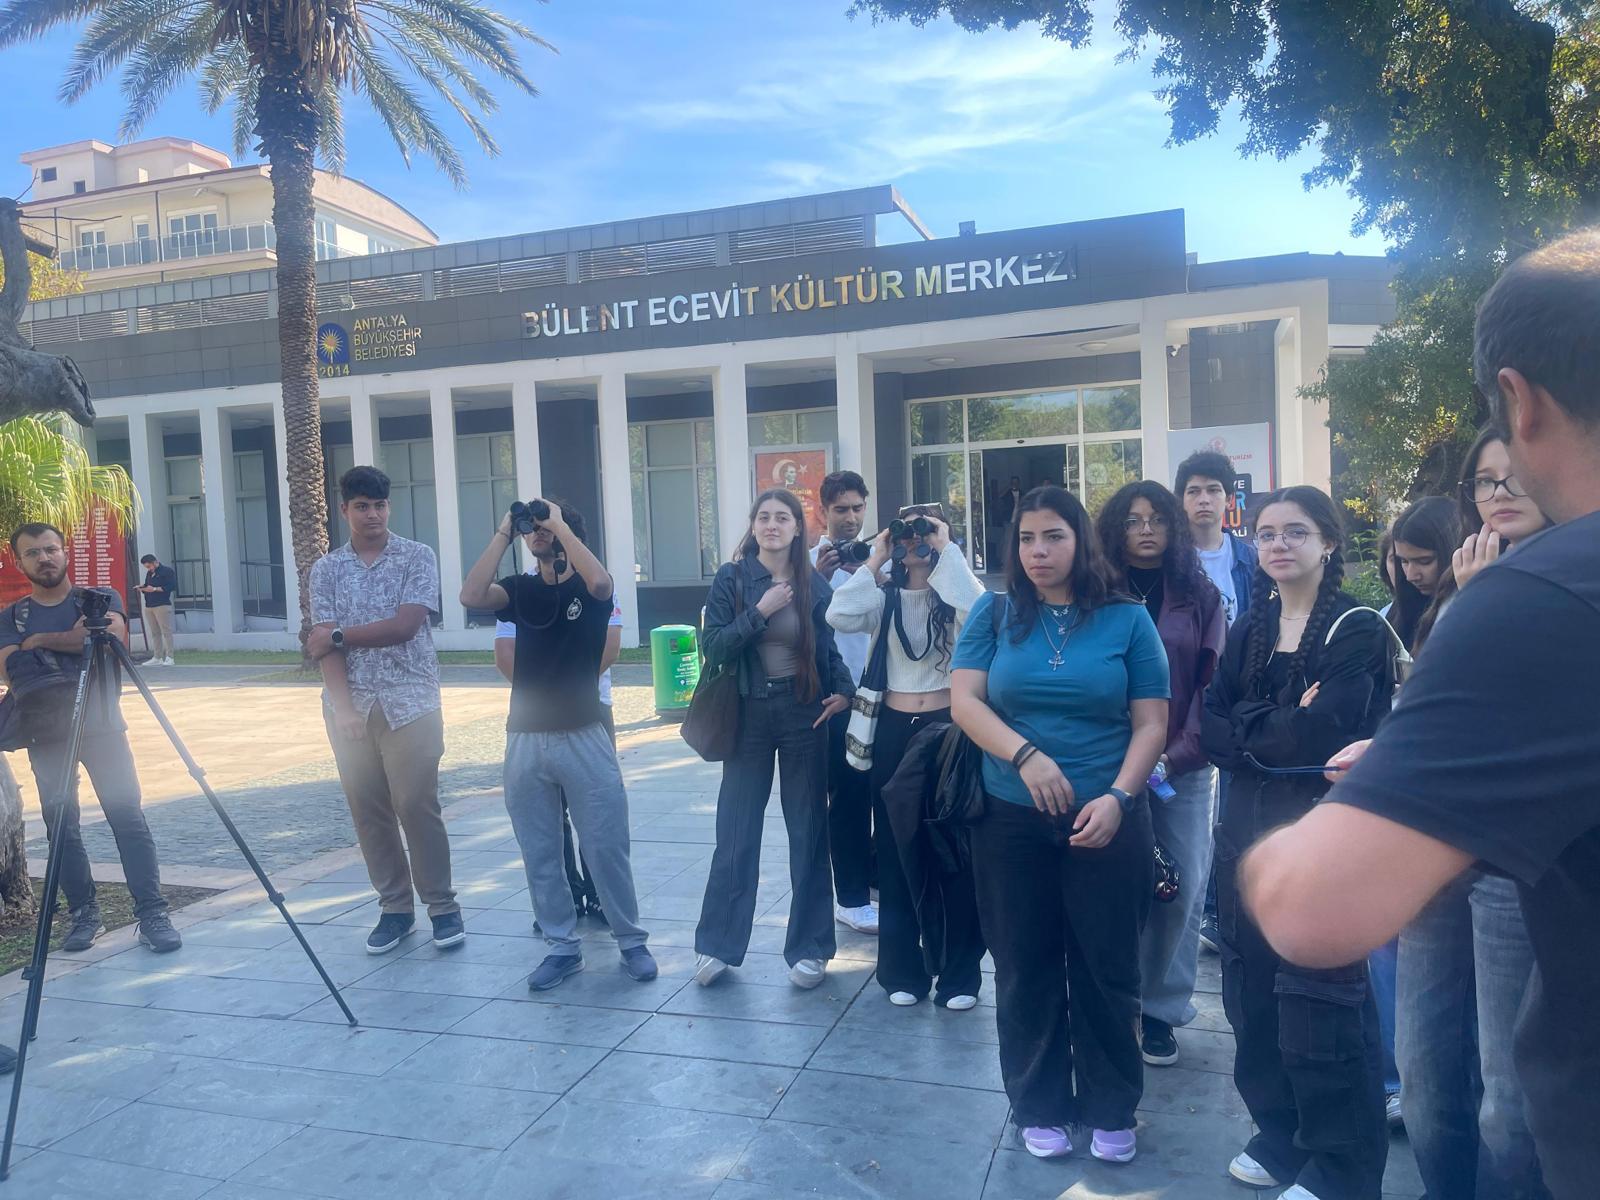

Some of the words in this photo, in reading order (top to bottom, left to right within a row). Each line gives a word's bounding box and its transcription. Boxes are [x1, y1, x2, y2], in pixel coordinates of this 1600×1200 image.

[521, 300, 639, 339] BÜLENT
[648, 282, 760, 326] ECEVİT
[771, 266, 905, 313] KÜLTÜR
[354, 314, 408, 331] ANTALYA
[355, 341, 416, 361] BELEDİYESİ
[320, 363, 350, 377] 2014
